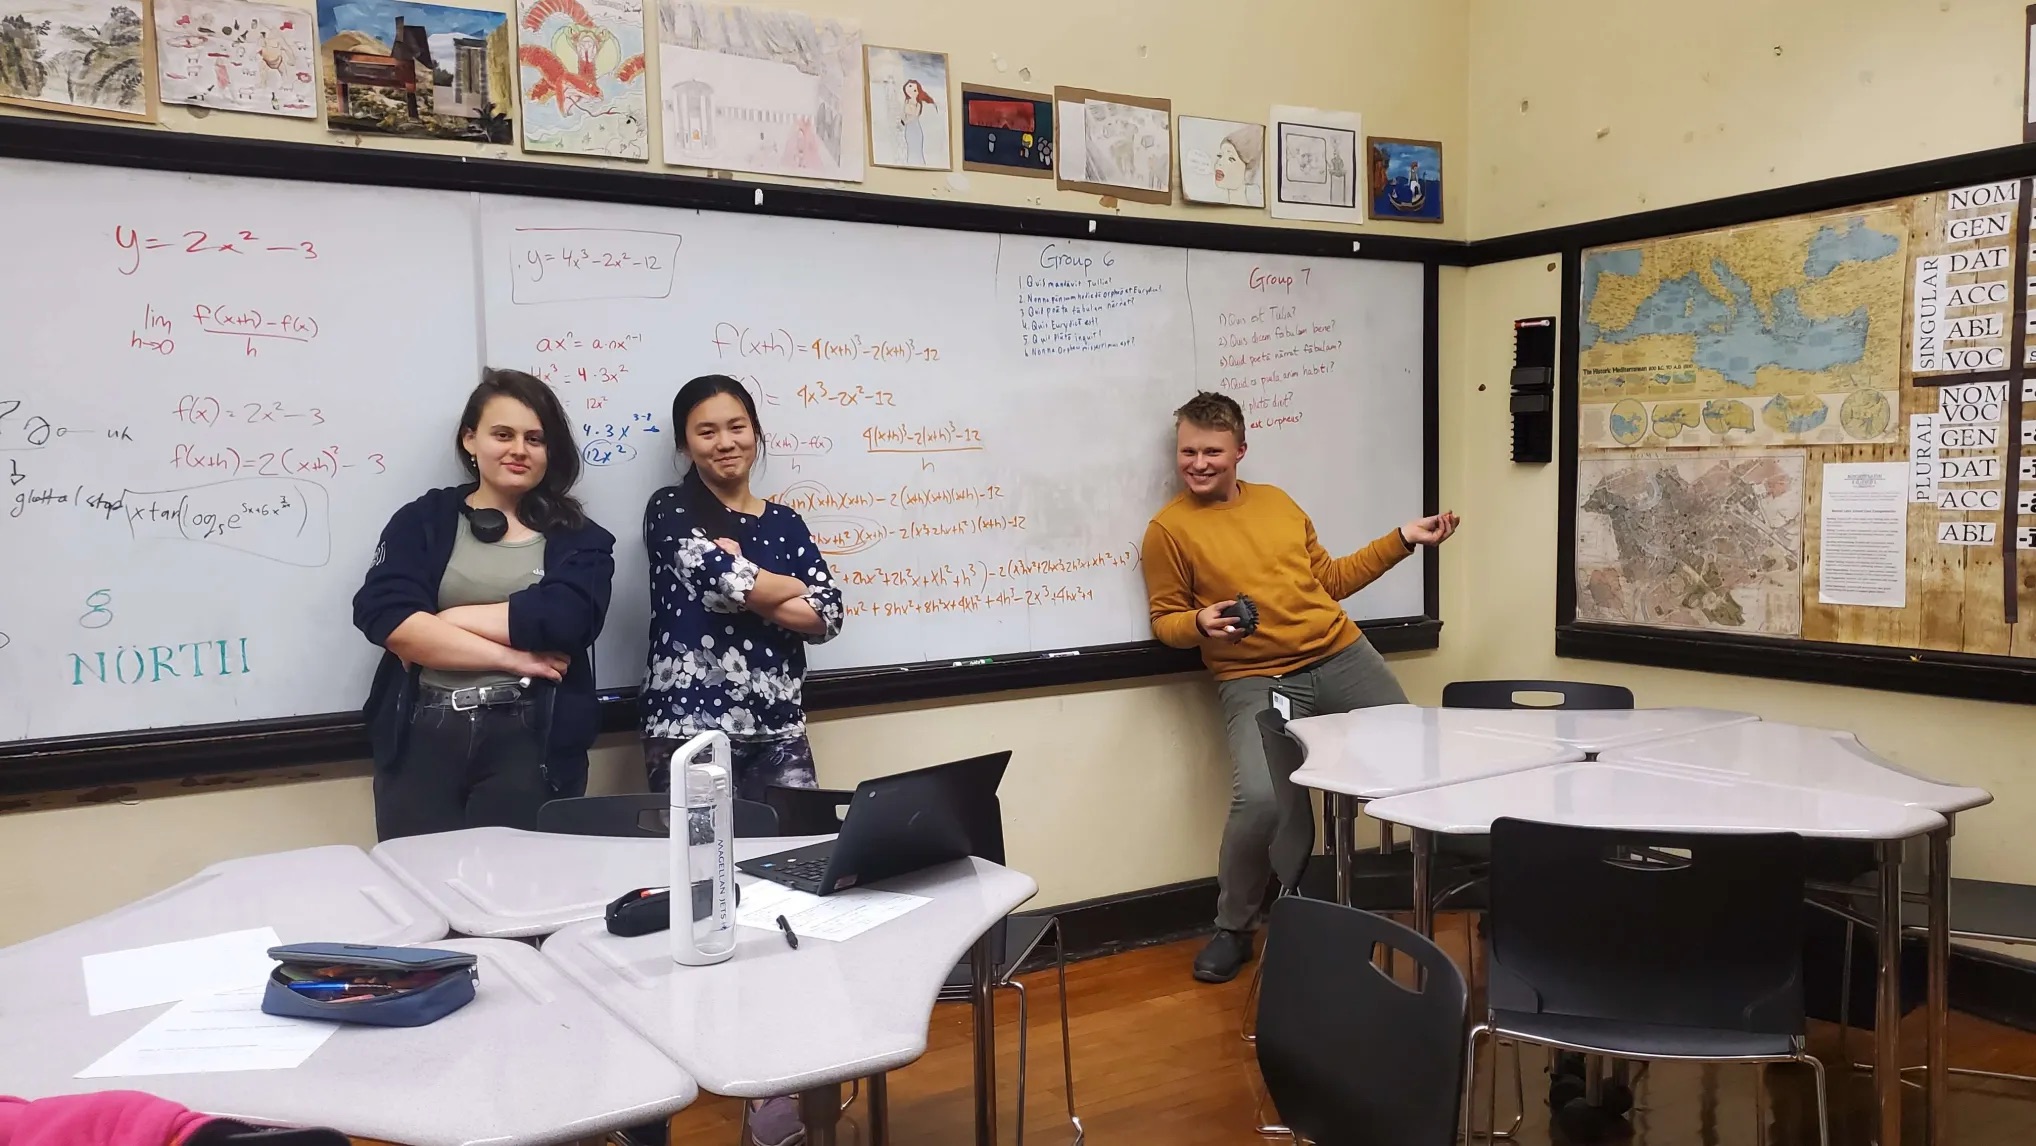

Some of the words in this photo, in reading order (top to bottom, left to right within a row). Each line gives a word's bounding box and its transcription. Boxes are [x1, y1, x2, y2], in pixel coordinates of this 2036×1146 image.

[1951, 183, 2017, 210] NOM
[1950, 215, 2007, 240] GEN
[1040, 244, 1092, 276] Group
[1103, 251, 1115, 267] 6
[1949, 249, 2007, 272] DAT
[1250, 267, 1293, 294] Group
[1301, 268, 1311, 285] 7
[1947, 284, 2006, 307] ACC
[144, 303, 172, 331] lim
[1920, 257, 1939, 369] SINGULAR
[1948, 317, 1999, 339] ABL
[245, 337, 258, 358] h
[1946, 347, 2003, 369] VOC
[1942, 385, 2007, 405] NOM
[1942, 403, 1998, 422] VOC
[1250, 421, 1264, 429] est
[1941, 428, 1997, 447] GEN
[791, 457, 801, 472] h
[921, 457, 936, 473] h
[1916, 416, 1932, 500] PLURAL
[1940, 458, 1997, 479] DAT
[1940, 490, 1998, 508] ACC
[1942, 524, 1993, 543] ABL
[716, 839, 727, 895] MAGELLAN
[719, 898, 728, 920] JETS
